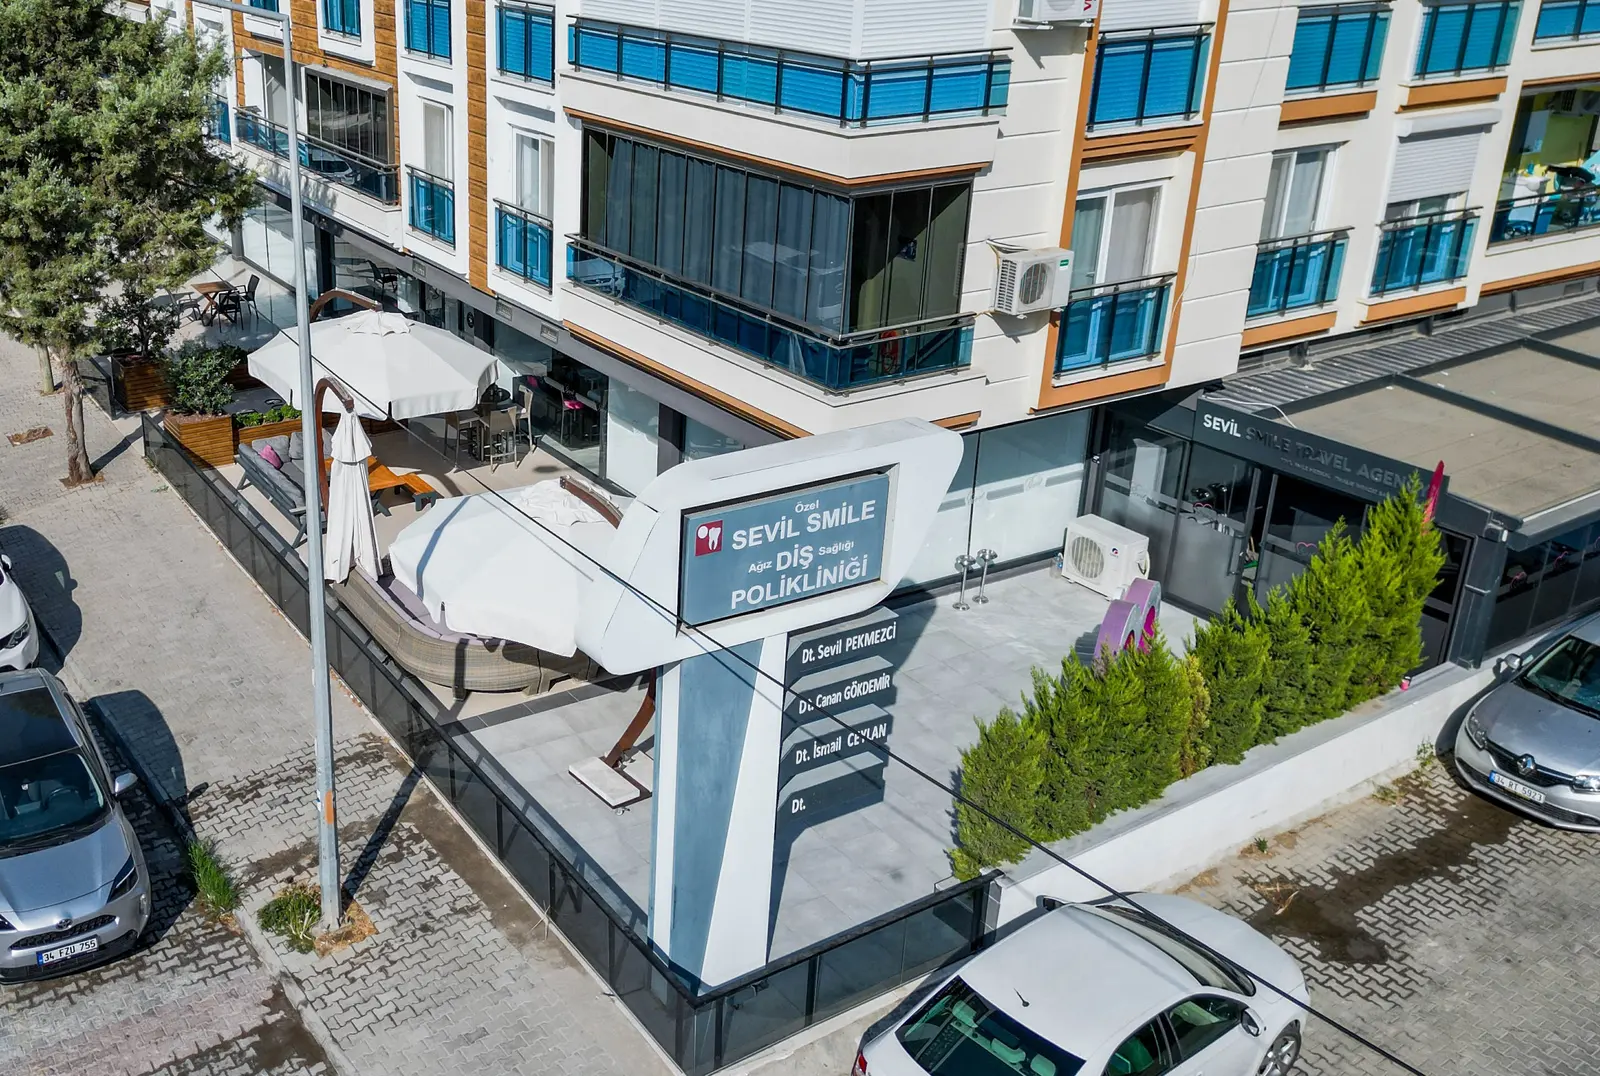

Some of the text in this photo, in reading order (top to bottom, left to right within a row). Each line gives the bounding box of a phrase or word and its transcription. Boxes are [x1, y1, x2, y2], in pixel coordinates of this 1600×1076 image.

[1203, 413, 1241, 438] SEVİL
[1245, 426, 1291, 452] SMILE
[1295, 441, 1352, 473] TRAVEL
[731, 500, 876, 550] SEVİL SMİLE
[794, 499, 820, 514] Özel
[748, 540, 855, 575] Ağız DİŞ Sağlığı
[731, 553, 868, 610] POLİKLİNİĞİ
[802, 621, 897, 664] Dt. Sevil PEKMEZCİ
[798, 672, 891, 715] Dt. Canan GÖKDEMİR
[795, 722, 888, 765] Dt. İsmail CEYLAN
[1496, 775, 1505, 785] 34
[1508, 781, 1519, 791] RT
[791, 798, 806, 814] Dt.
[44, 940, 96, 962] 34 FZU 755
